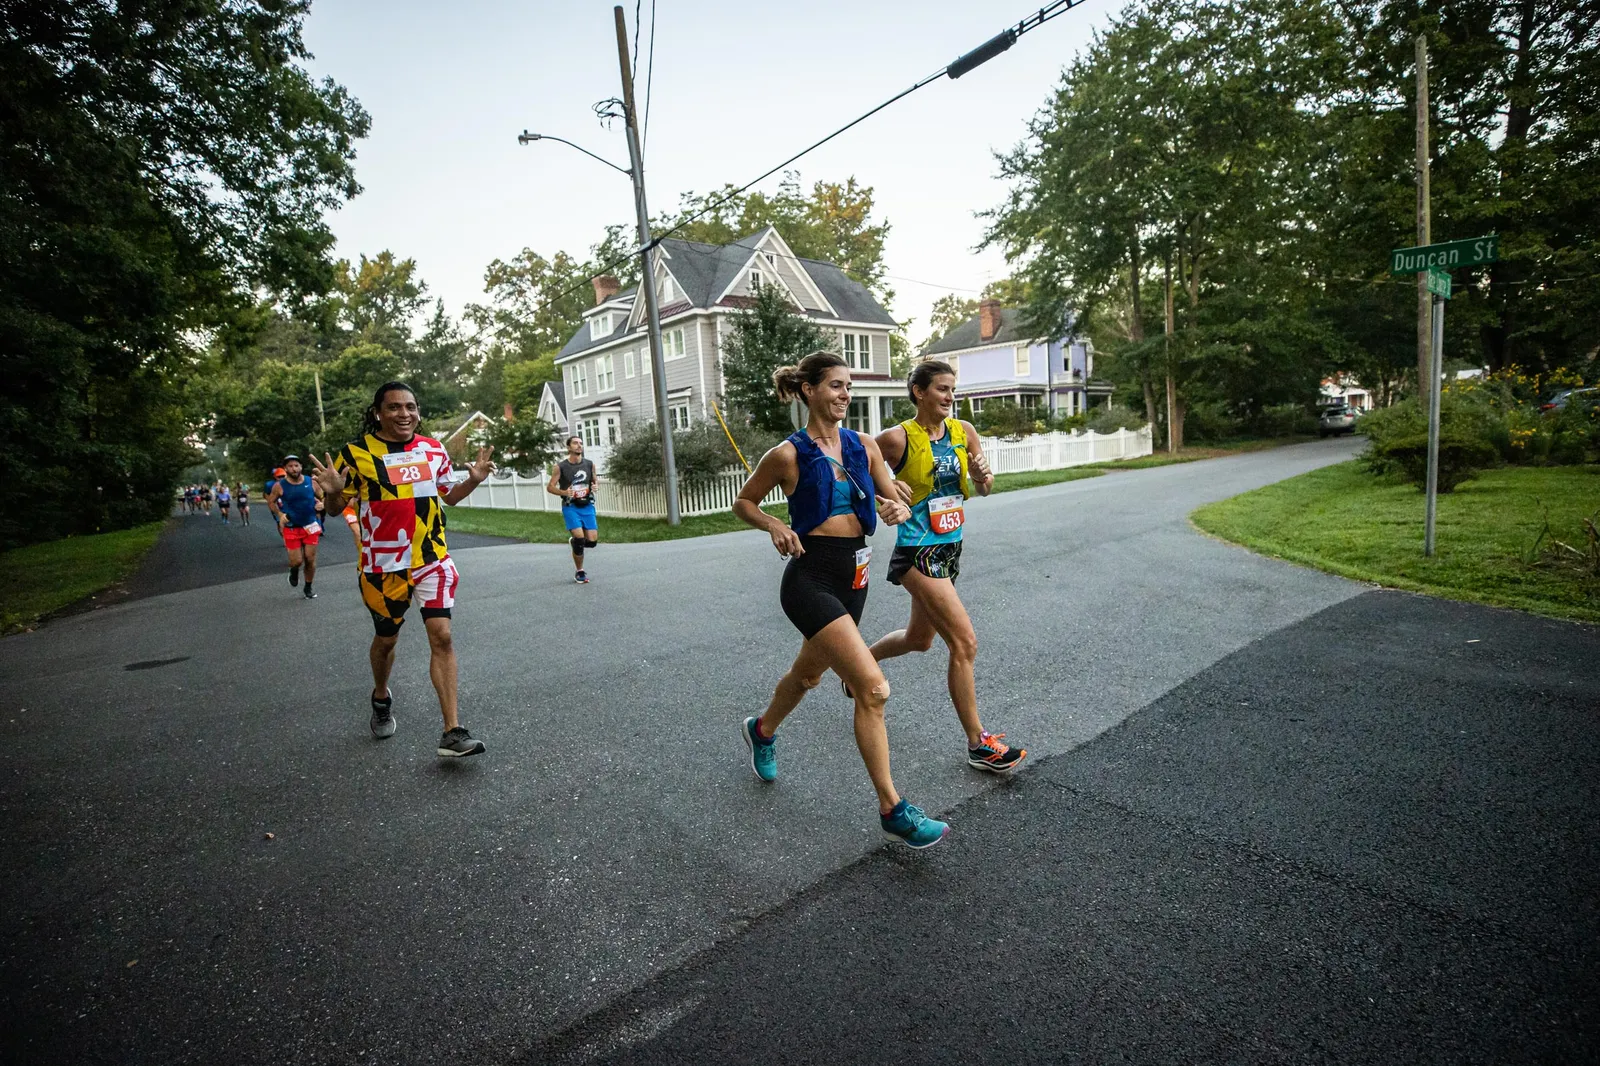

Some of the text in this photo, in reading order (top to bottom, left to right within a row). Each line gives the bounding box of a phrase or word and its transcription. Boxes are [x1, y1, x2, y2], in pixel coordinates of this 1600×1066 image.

[1394, 240, 1494, 271] Duncan St
[399, 465, 422, 482] 28
[939, 511, 961, 530] 453
